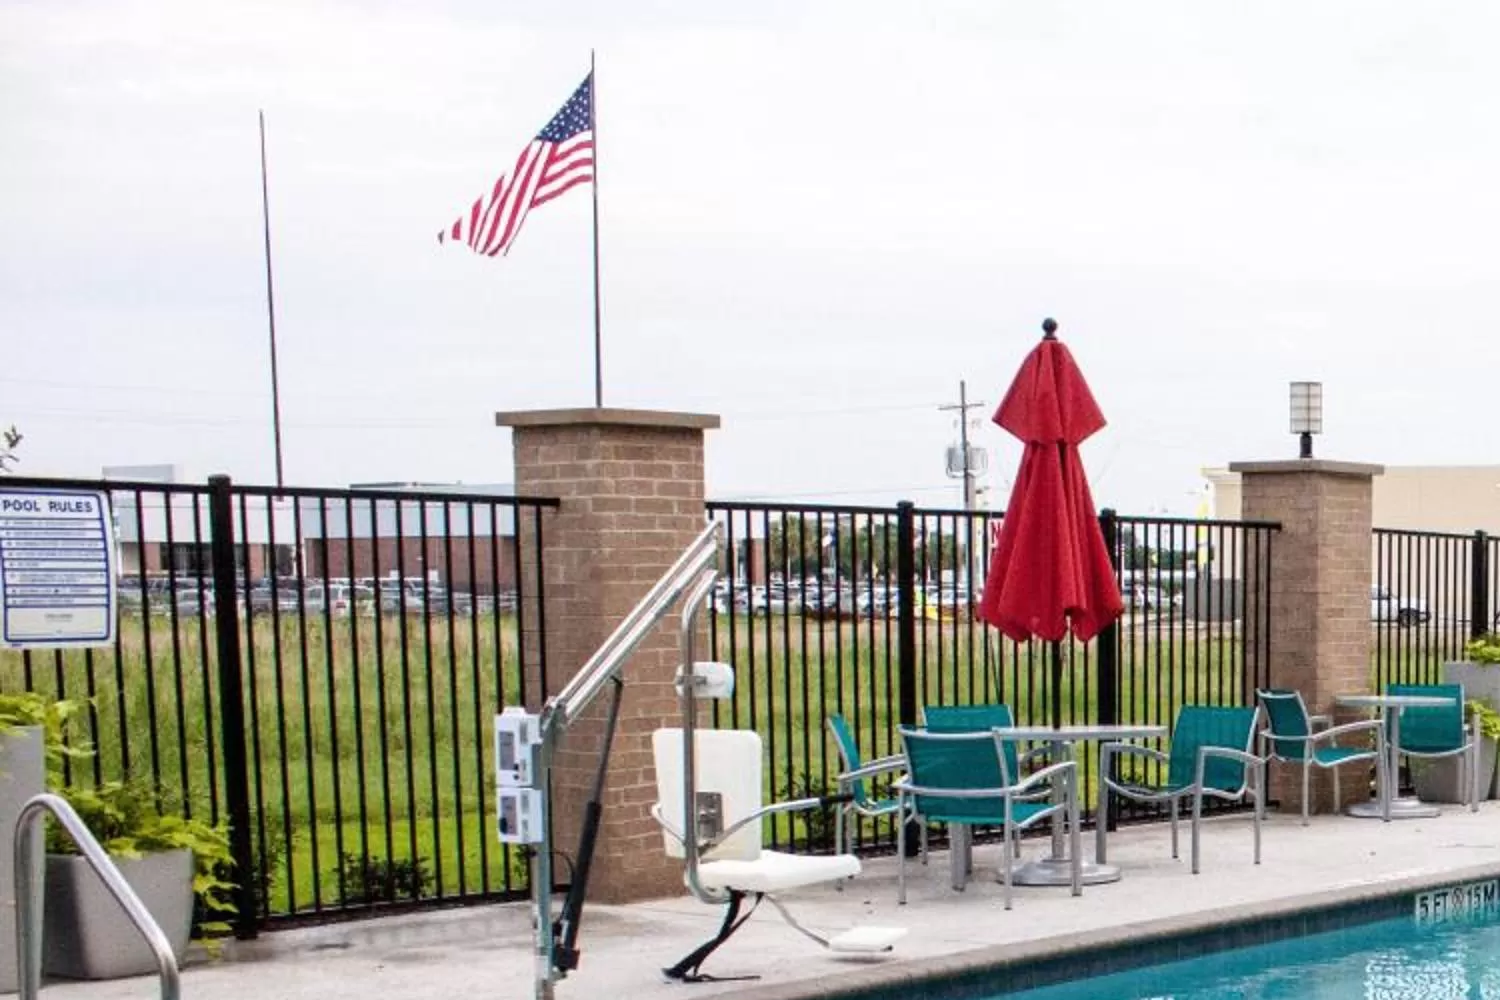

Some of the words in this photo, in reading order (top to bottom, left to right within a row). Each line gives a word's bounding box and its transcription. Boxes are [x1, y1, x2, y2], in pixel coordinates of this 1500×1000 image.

[2, 499, 41, 512] POOL
[48, 501, 94, 513] RULES
[1433, 891, 1449, 917] FT
